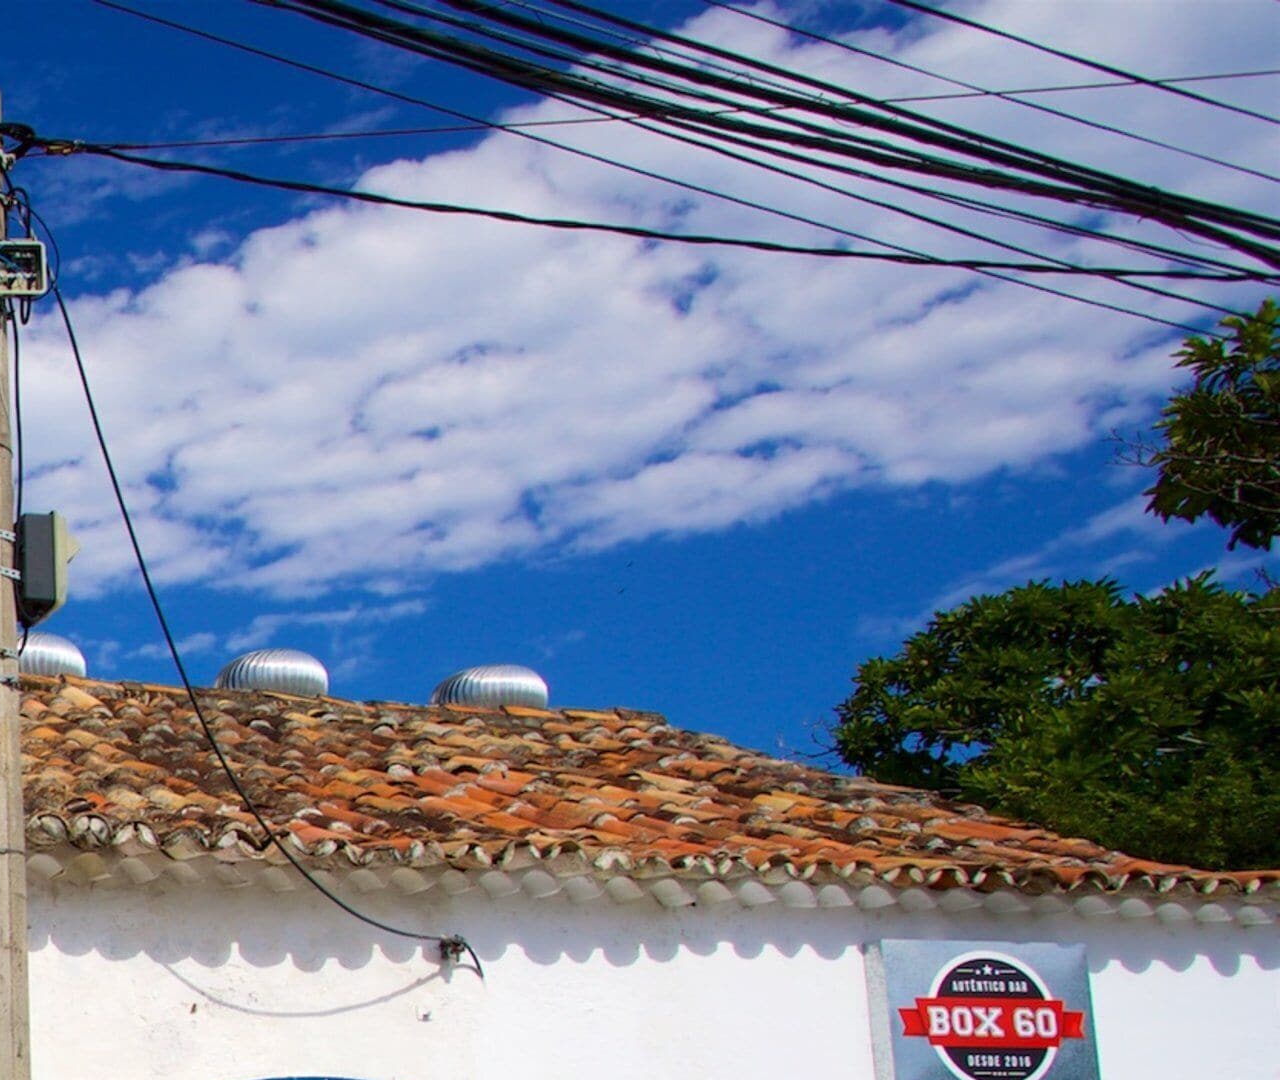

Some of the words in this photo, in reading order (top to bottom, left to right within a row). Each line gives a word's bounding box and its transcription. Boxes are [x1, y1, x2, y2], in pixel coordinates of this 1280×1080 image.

[952, 979, 1006, 992] AUTÊNTICO
[1008, 981, 1028, 992] BAR
[927, 1006, 1005, 1038] BOX
[1013, 1008, 1058, 1038] 60
[967, 1054, 1001, 1067] DESDE
